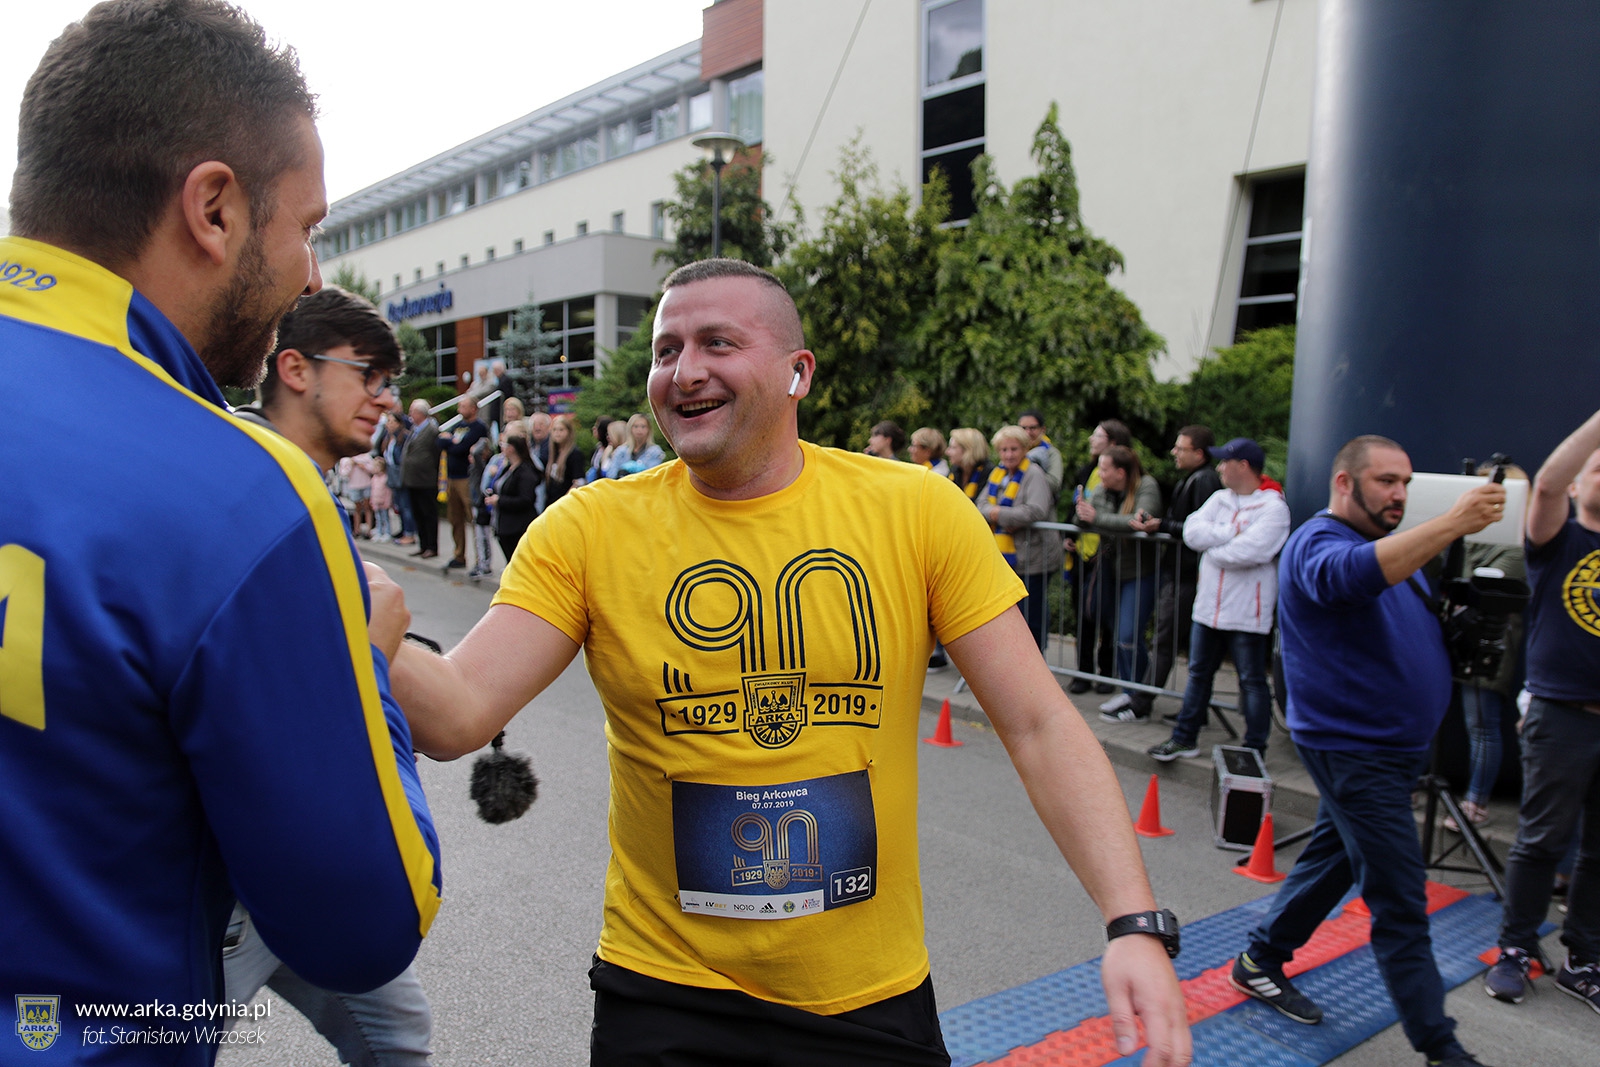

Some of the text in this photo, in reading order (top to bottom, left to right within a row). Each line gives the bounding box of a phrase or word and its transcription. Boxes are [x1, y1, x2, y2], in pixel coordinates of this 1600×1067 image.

[678, 693, 867, 726] 1929 2019
[755, 712, 796, 724] ARKA
[735, 788, 808, 802] Bieg Arkowca
[752, 800, 794, 809] 07.07.2019
[740, 869, 763, 881] 1929
[791, 867, 815, 878] 2019
[834, 873, 869, 896] 132
